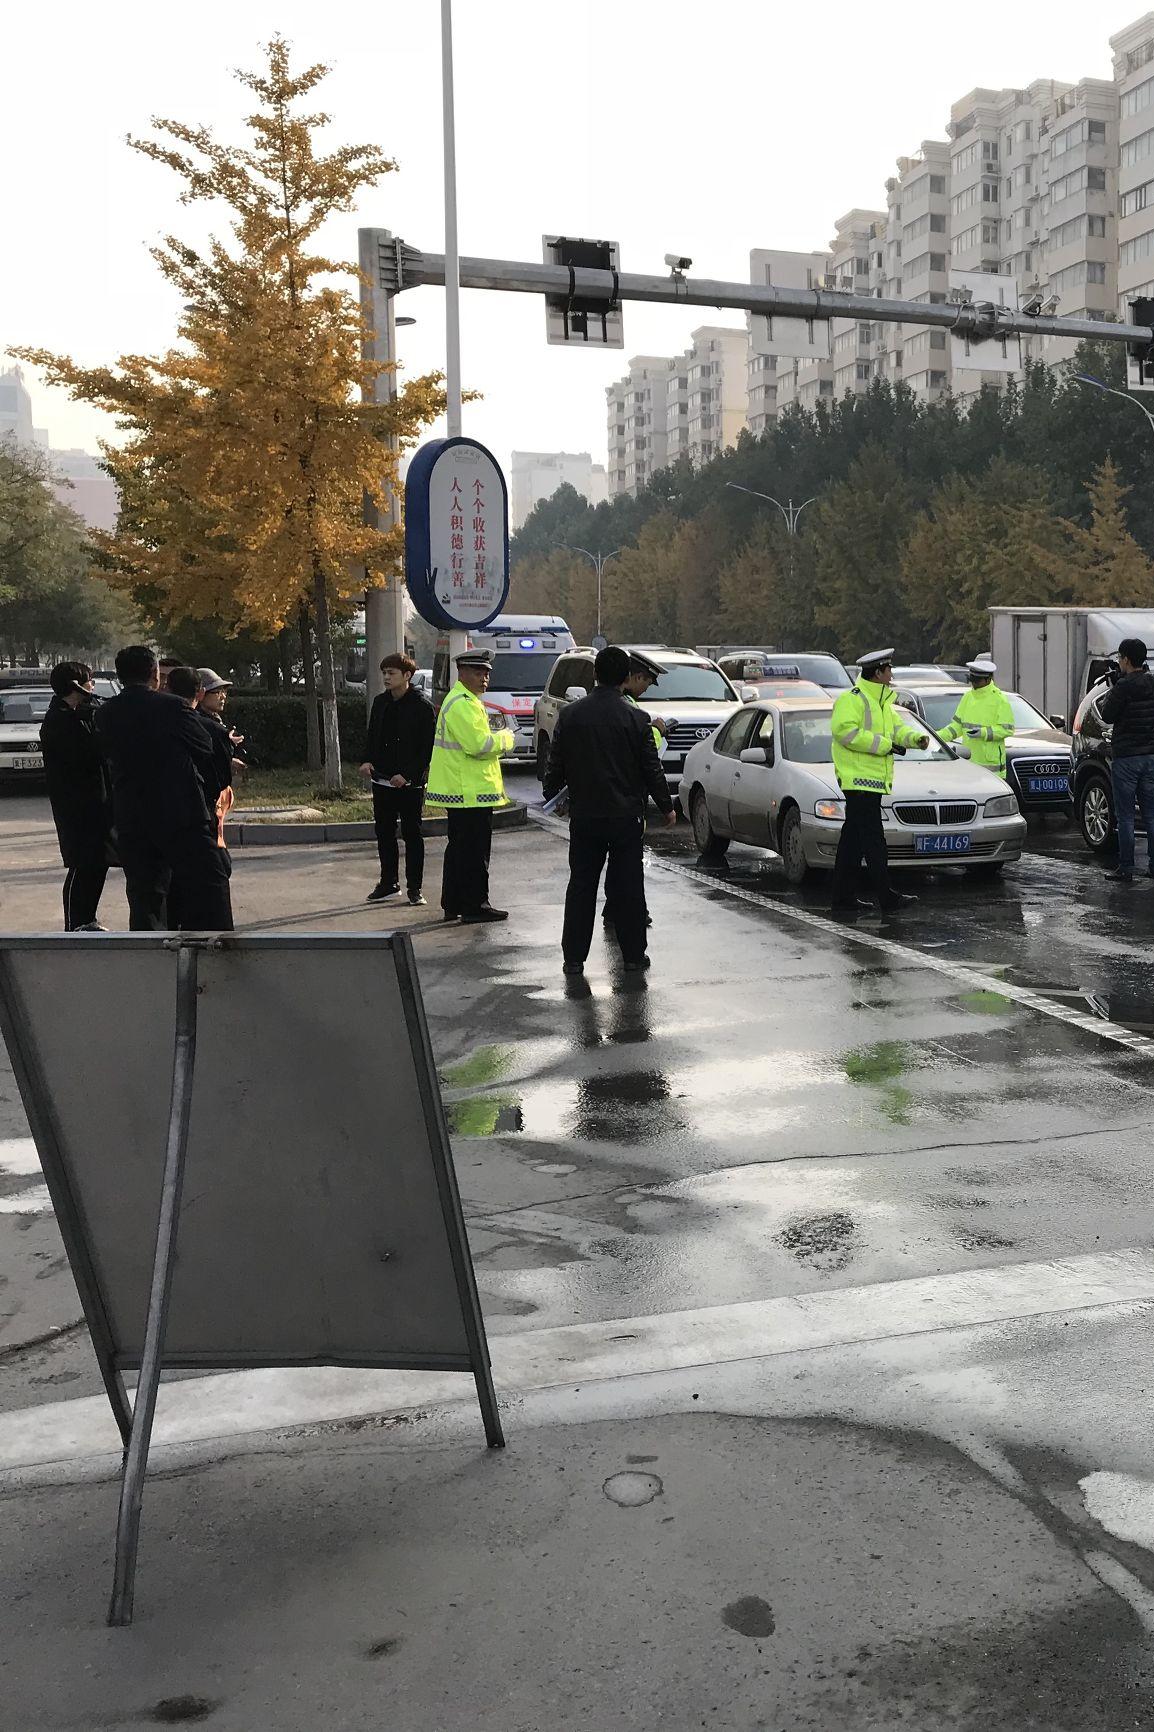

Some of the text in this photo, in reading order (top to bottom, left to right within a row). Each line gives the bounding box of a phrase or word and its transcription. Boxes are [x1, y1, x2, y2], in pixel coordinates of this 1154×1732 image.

[450, 476, 464, 588] 人人积德行善
[472, 478, 487, 589] 个个收获吉祥
